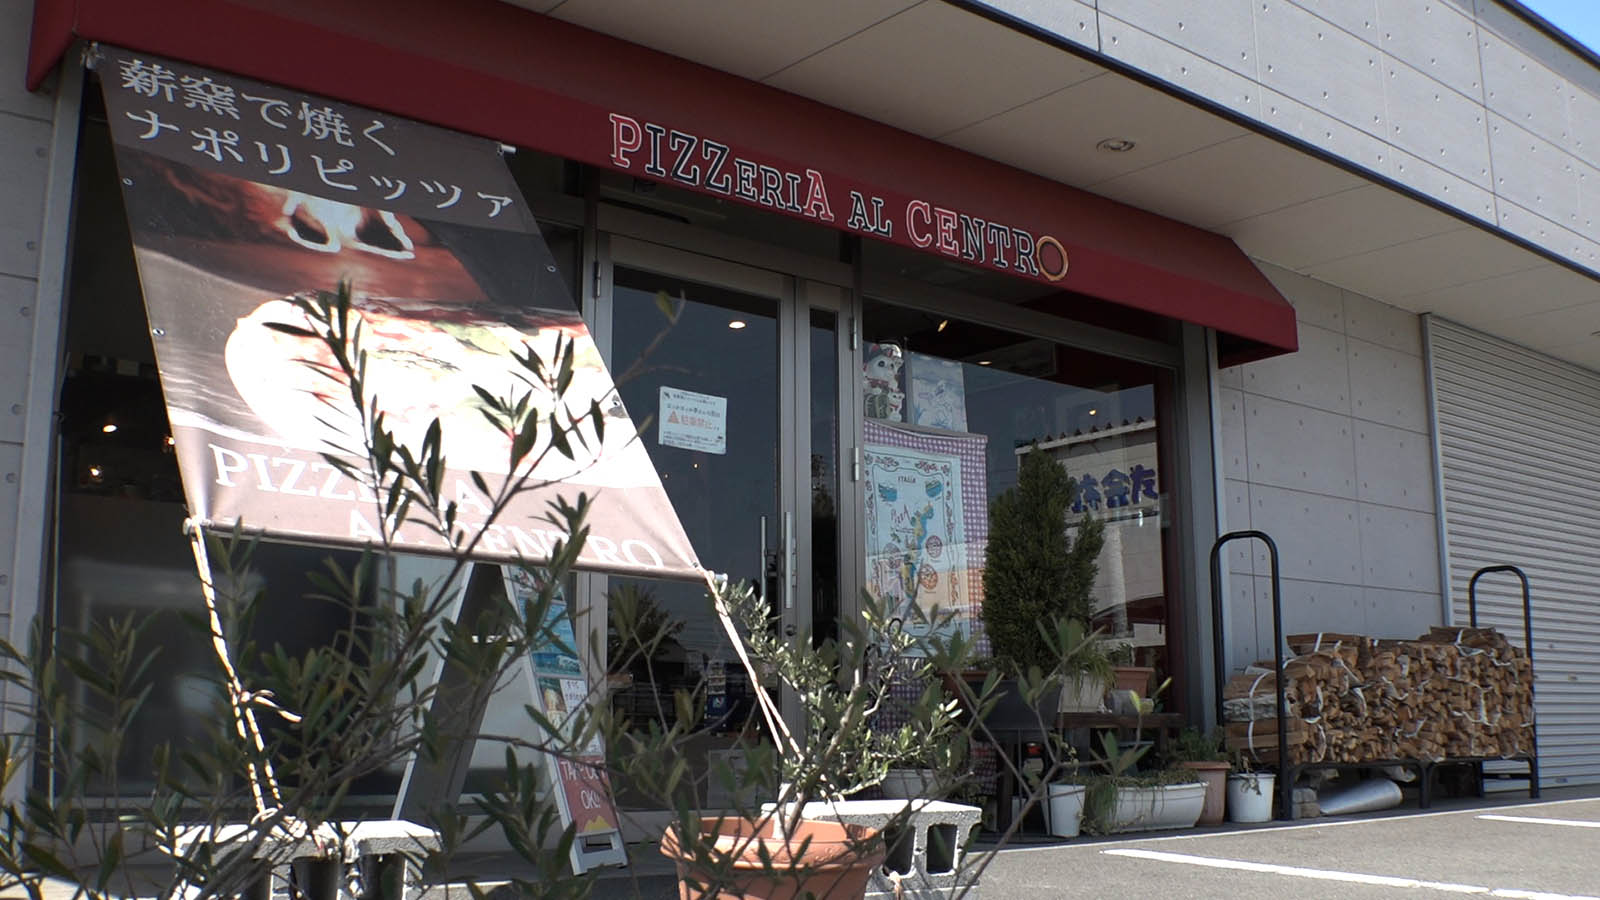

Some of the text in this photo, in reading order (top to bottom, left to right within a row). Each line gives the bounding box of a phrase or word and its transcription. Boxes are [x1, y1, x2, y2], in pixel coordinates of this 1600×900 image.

[117, 57, 396, 156] 薪窯で焼く
[125, 109, 514, 218] ナポリピッツァ
[609, 112, 1069, 282] PIZZERIA AL CENTRO
[208, 443, 494, 516] PIZZEA
